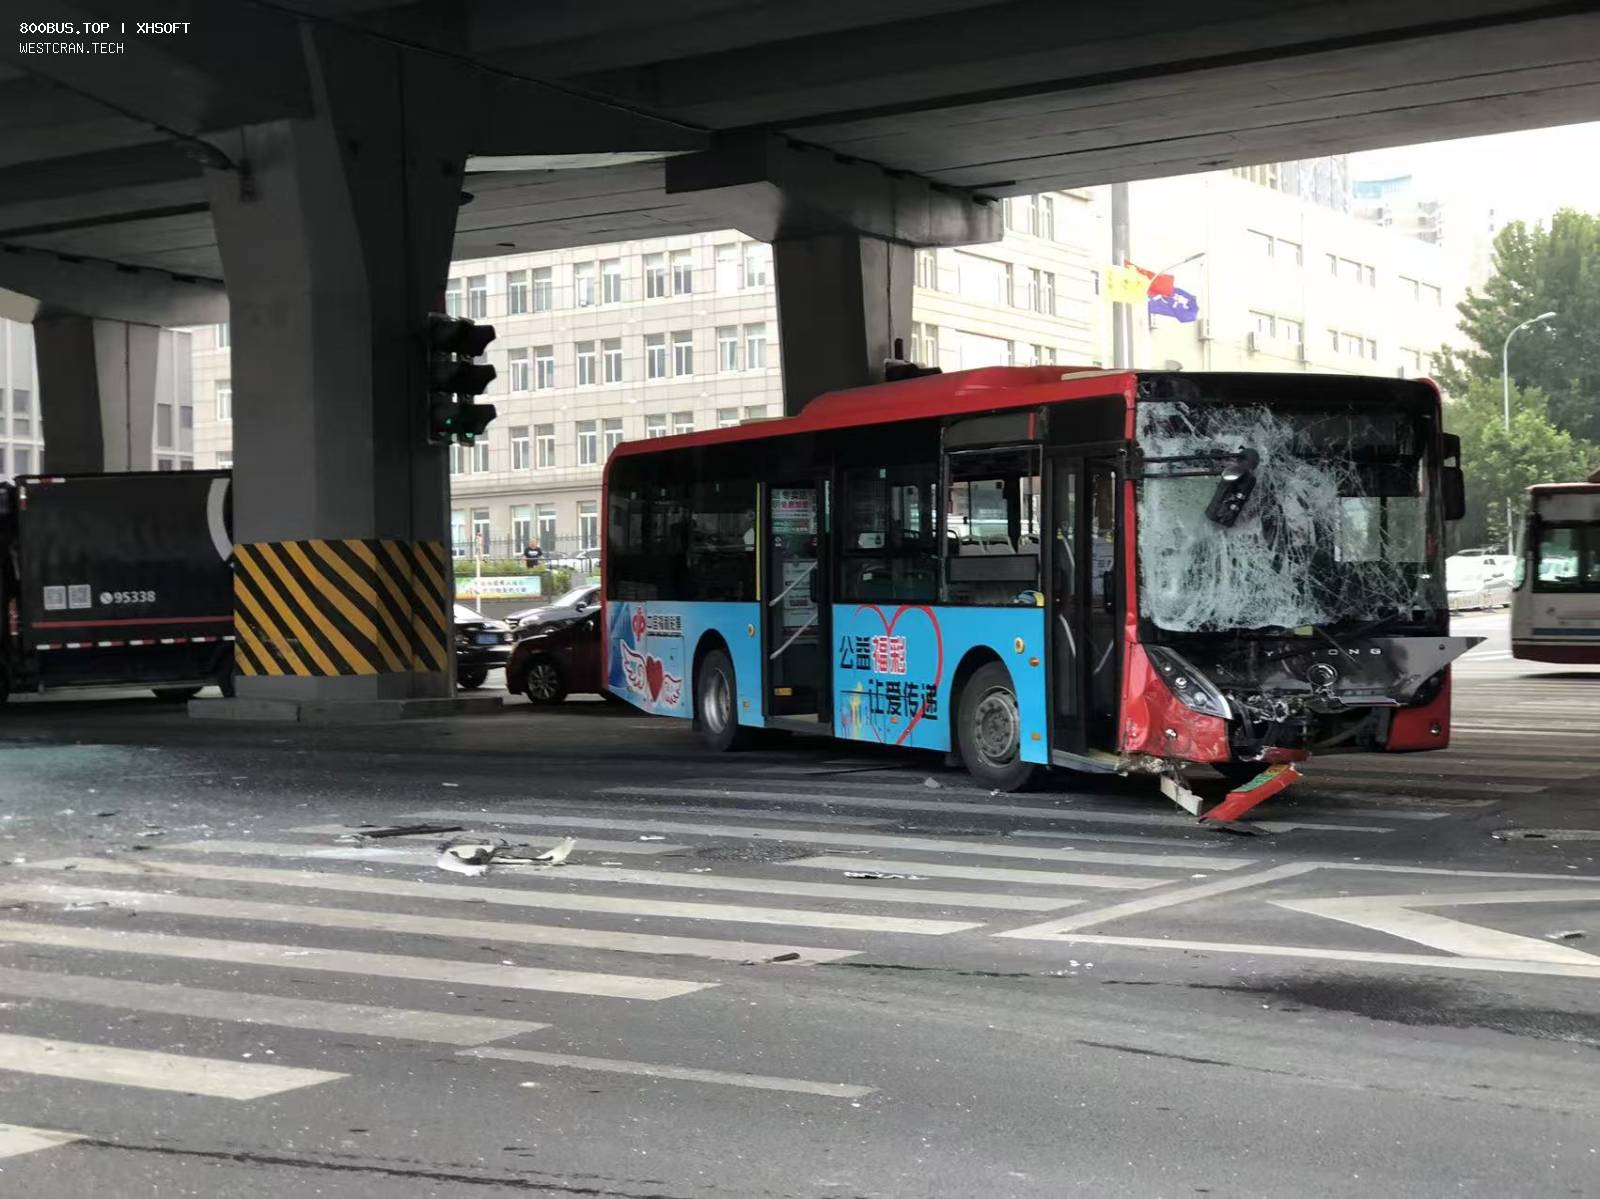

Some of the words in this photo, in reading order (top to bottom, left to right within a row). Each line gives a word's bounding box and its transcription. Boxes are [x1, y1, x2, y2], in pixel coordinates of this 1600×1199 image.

[114, 591, 156, 604] 95338
[840, 635, 907, 674] 公益福彩
[1265, 648, 1382, 657] YONG
[868, 679, 938, 720] 让爱传递
